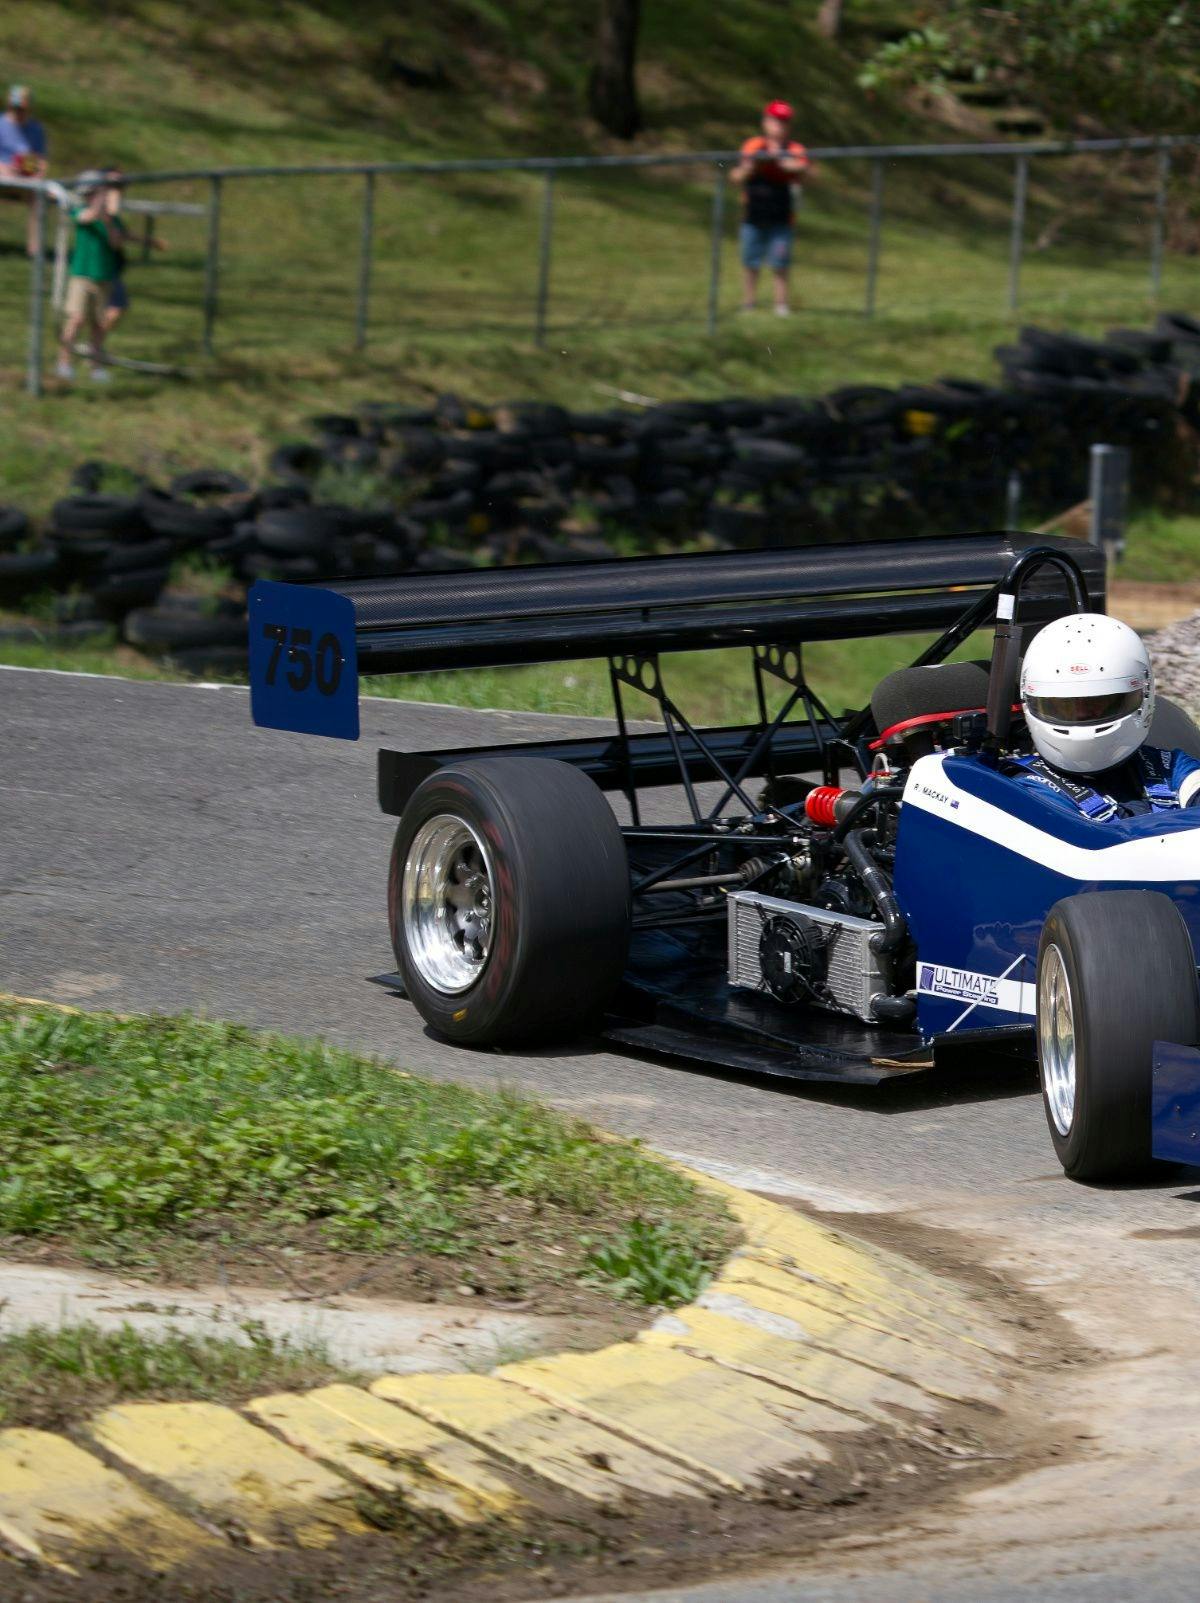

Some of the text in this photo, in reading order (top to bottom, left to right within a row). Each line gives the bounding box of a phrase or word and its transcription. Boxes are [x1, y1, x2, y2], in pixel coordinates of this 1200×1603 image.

[263, 623, 343, 696] 750
[1069, 664, 1089, 673] BELL
[922, 786, 949, 804] MACKAY
[936, 985, 962, 995] Power
